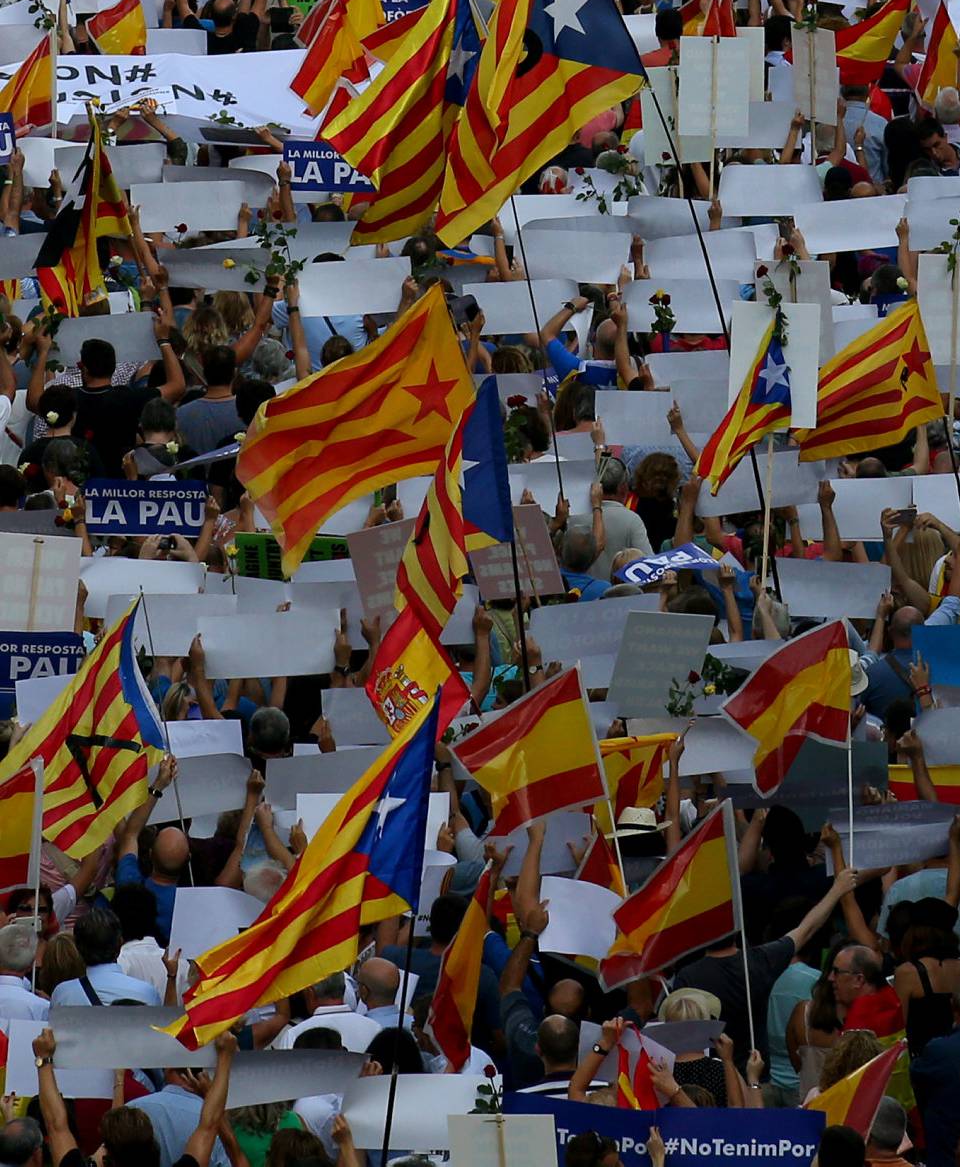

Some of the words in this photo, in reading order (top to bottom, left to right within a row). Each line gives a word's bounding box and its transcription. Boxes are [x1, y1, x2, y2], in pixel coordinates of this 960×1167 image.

[288, 149, 301, 158] LA
[289, 163, 325, 184] LA
[334, 164, 373, 185] PA
[85, 488, 99, 498] LA
[102, 488, 147, 499] MILLOR
[148, 489, 207, 500] RESPOSTA
[85, 500, 127, 525] LA
[139, 501, 206, 527] PAU
[23, 643, 85, 656] RESPOSTA
[665, 1137, 816, 1159] #NoTenimPor
